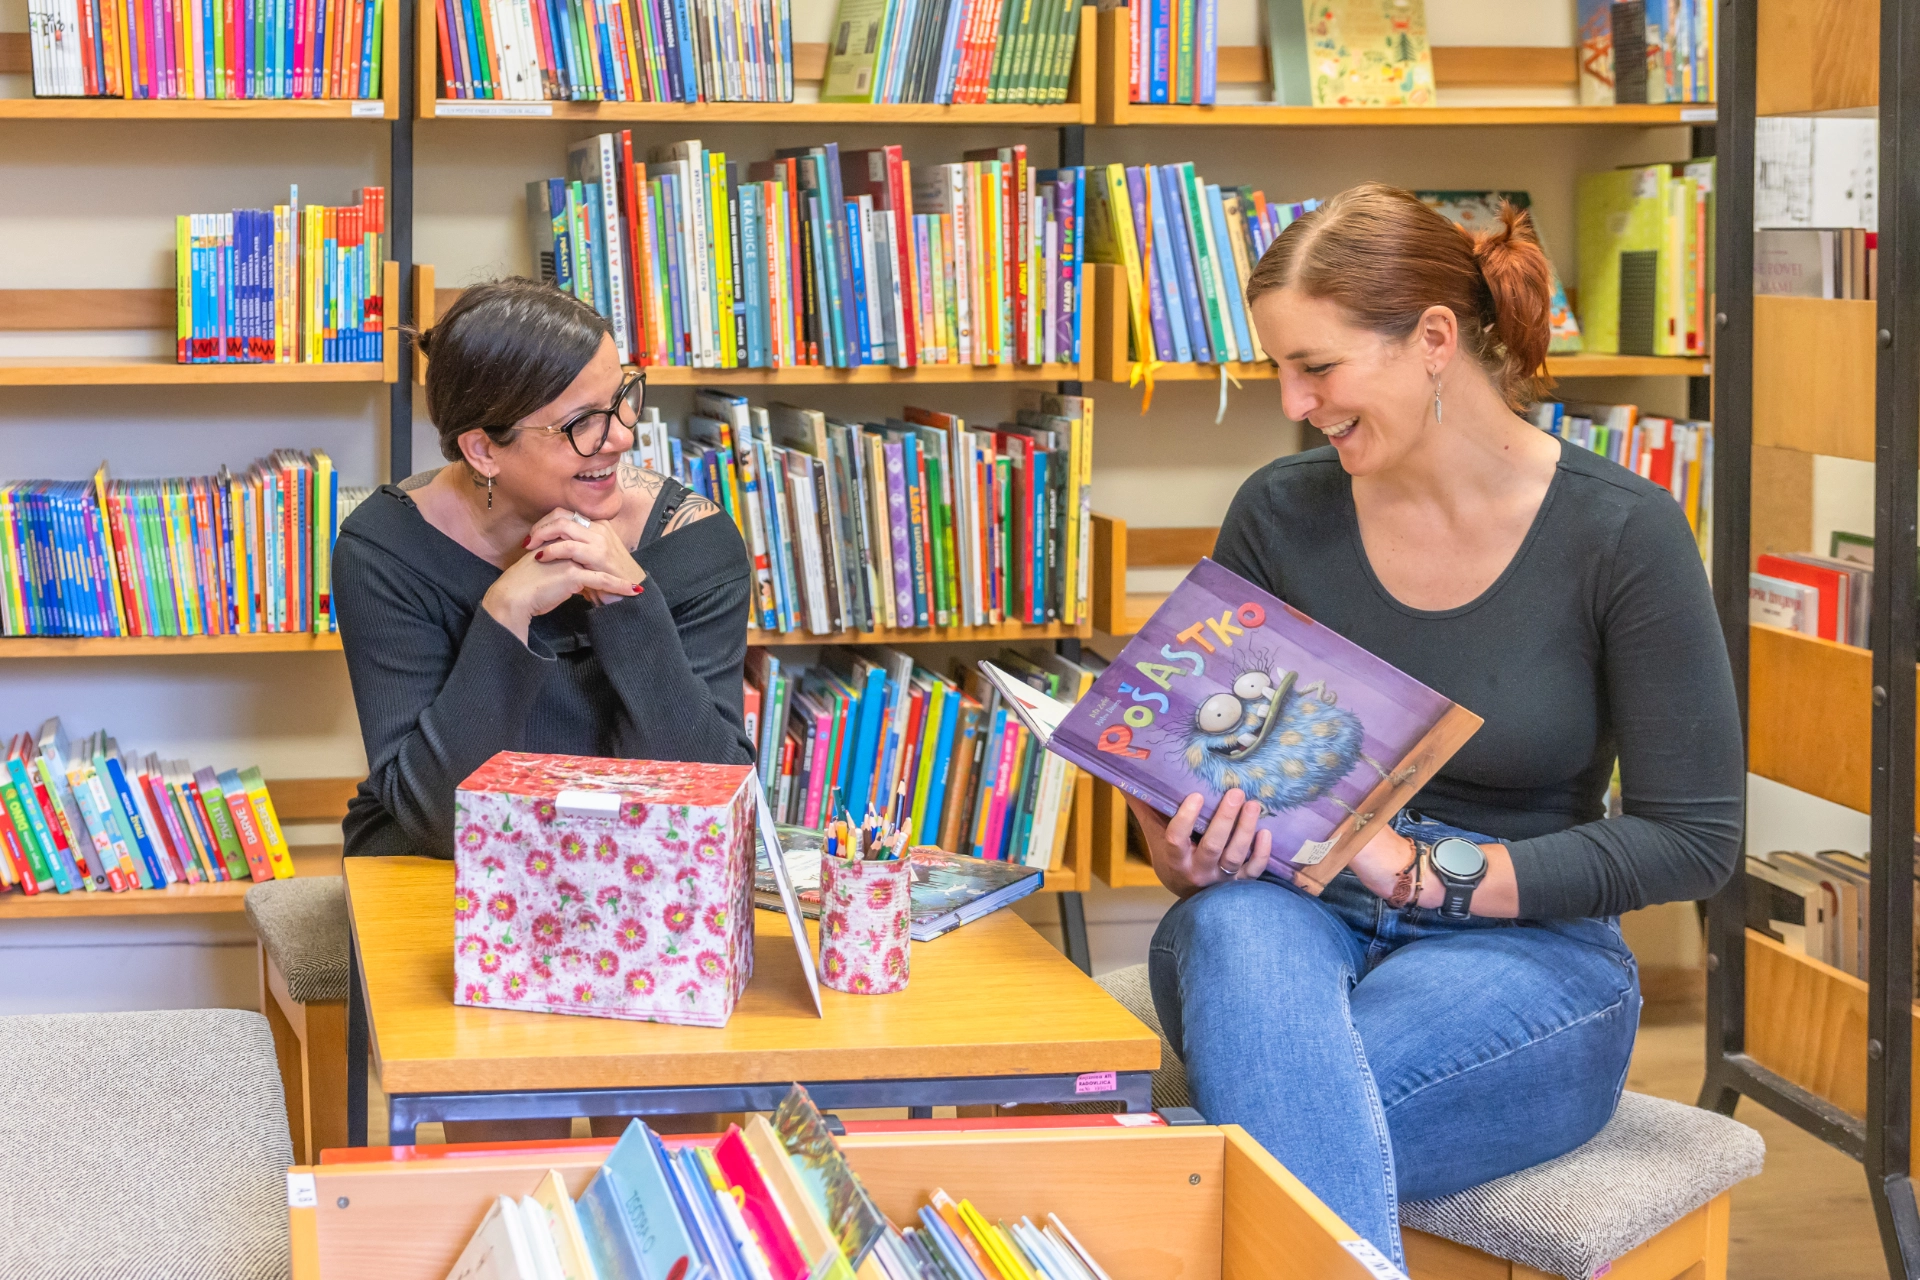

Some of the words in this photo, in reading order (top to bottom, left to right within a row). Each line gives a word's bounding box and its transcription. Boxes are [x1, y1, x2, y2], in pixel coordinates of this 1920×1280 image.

[693, 169, 701, 194] SLOVAR
[558, 236, 569, 278] POŠASTI
[608, 211, 619, 267] ATLAS
[1062, 280, 1072, 312] KAKO
[908, 484, 921, 524] SVET
[912, 525, 924, 572] ČUDOVITI
[916, 573, 925, 594] NAŠ
[1097, 602, 1266, 760] POŠASTKO
[10, 802, 29, 831] DINO
[130, 814, 145, 839] ŽIVALI
[212, 806, 233, 840] ŽIVALI
[236, 807, 258, 845] BARVE
[256, 804, 279, 846] BESEDE
